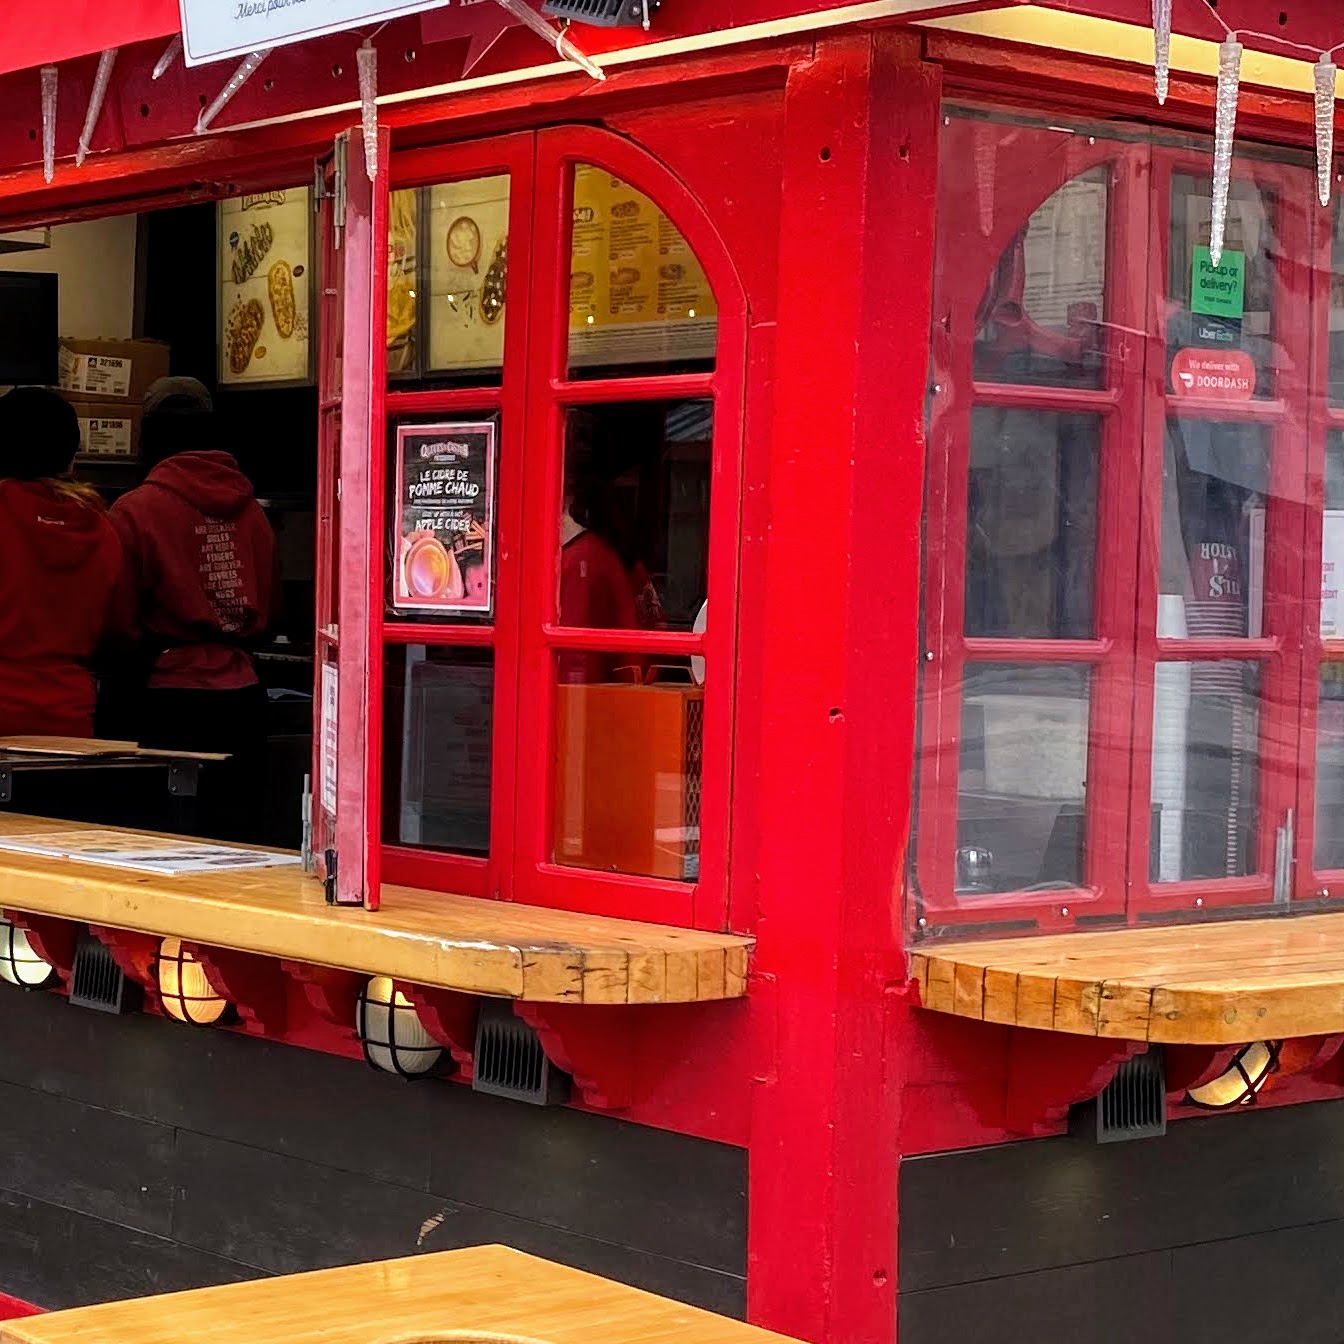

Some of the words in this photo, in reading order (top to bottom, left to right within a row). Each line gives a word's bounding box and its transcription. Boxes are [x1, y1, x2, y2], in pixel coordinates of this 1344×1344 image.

[1228, 266, 1239, 278] or
[1200, 276, 1238, 295] delivery?
[1198, 327, 1216, 339] Uber
[1188, 359, 1200, 370] We
[1224, 362, 1240, 372] with
[1197, 375, 1249, 390] DOORDASH
